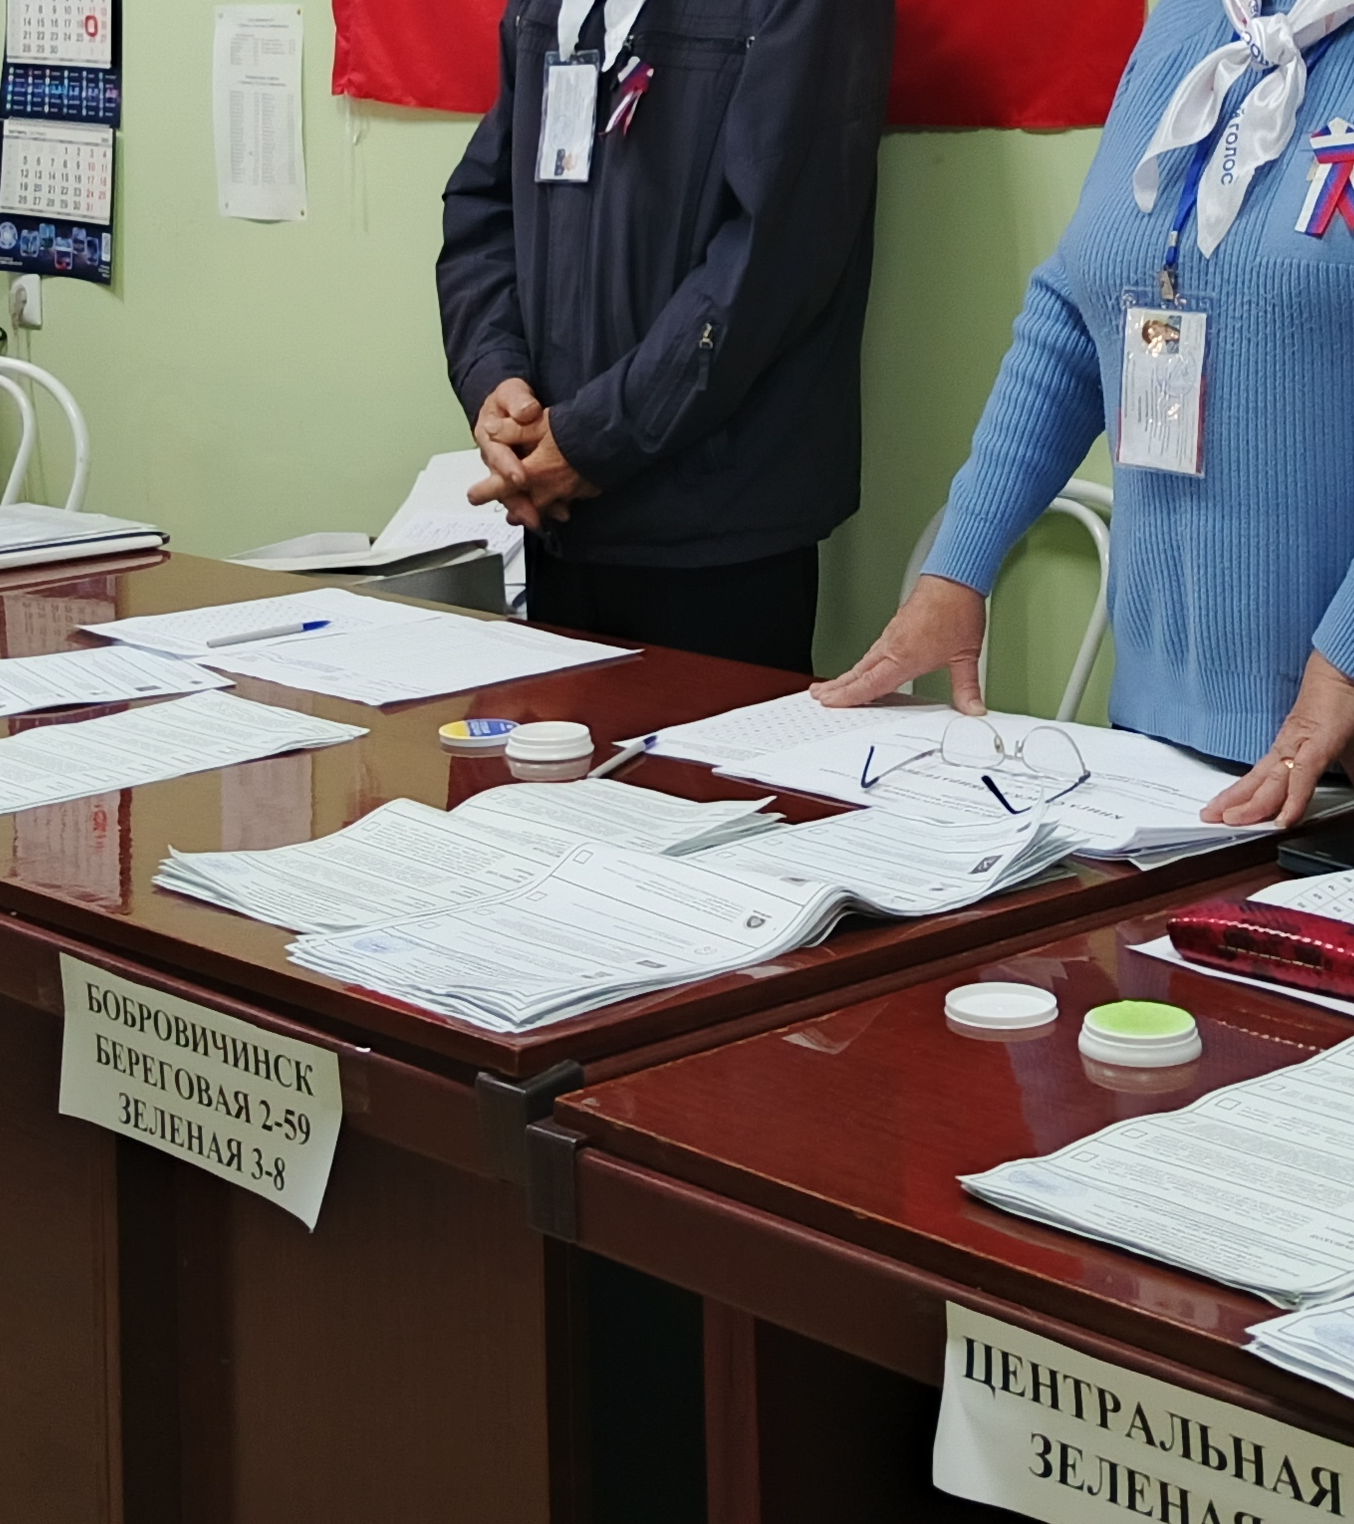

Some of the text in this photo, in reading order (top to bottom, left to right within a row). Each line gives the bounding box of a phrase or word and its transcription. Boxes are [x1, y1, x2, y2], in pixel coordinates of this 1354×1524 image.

[85, 981, 315, 1097] БОБРОВИЧИНСК
[94, 1032, 311, 1145] БЕРЕГОВАЯ 2-59
[117, 1092, 286, 1191] ЗЕЛЕНАЯ 3-8
[963, 1335, 1344, 1517] ЦЕНТРАЛЬНАЯ
